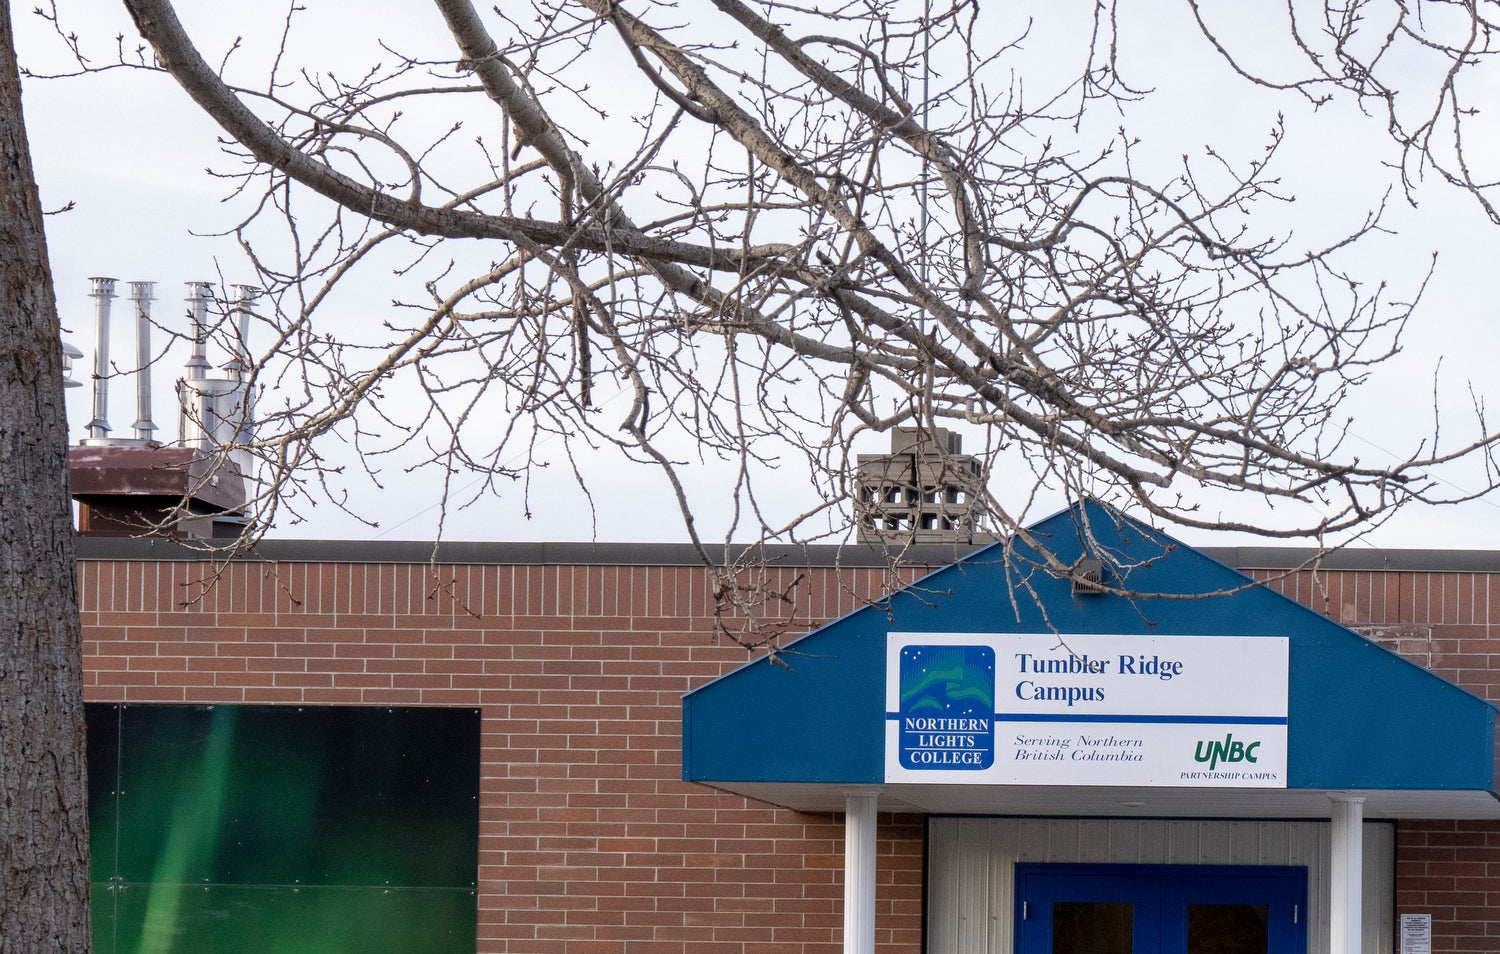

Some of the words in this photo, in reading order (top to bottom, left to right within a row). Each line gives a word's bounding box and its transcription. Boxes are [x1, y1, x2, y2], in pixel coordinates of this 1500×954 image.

[1015, 653, 1110, 674] Tumbler
[1118, 655, 1183, 681] Ridge
[1015, 680, 1105, 706] Campus
[905, 717, 989, 731] NORTHERN
[919, 734, 975, 747] LIGHTS
[1014, 734, 1072, 749] Serving
[1076, 735, 1144, 747] Northern
[910, 751, 982, 764] COLLEGE
[1014, 749, 1065, 761] British
[1071, 750, 1144, 762] Columbia
[1194, 733, 1261, 771] UNBC
[1180, 772, 1241, 780] PARTNERSHIP
[1242, 772, 1278, 780] CAMPUS
